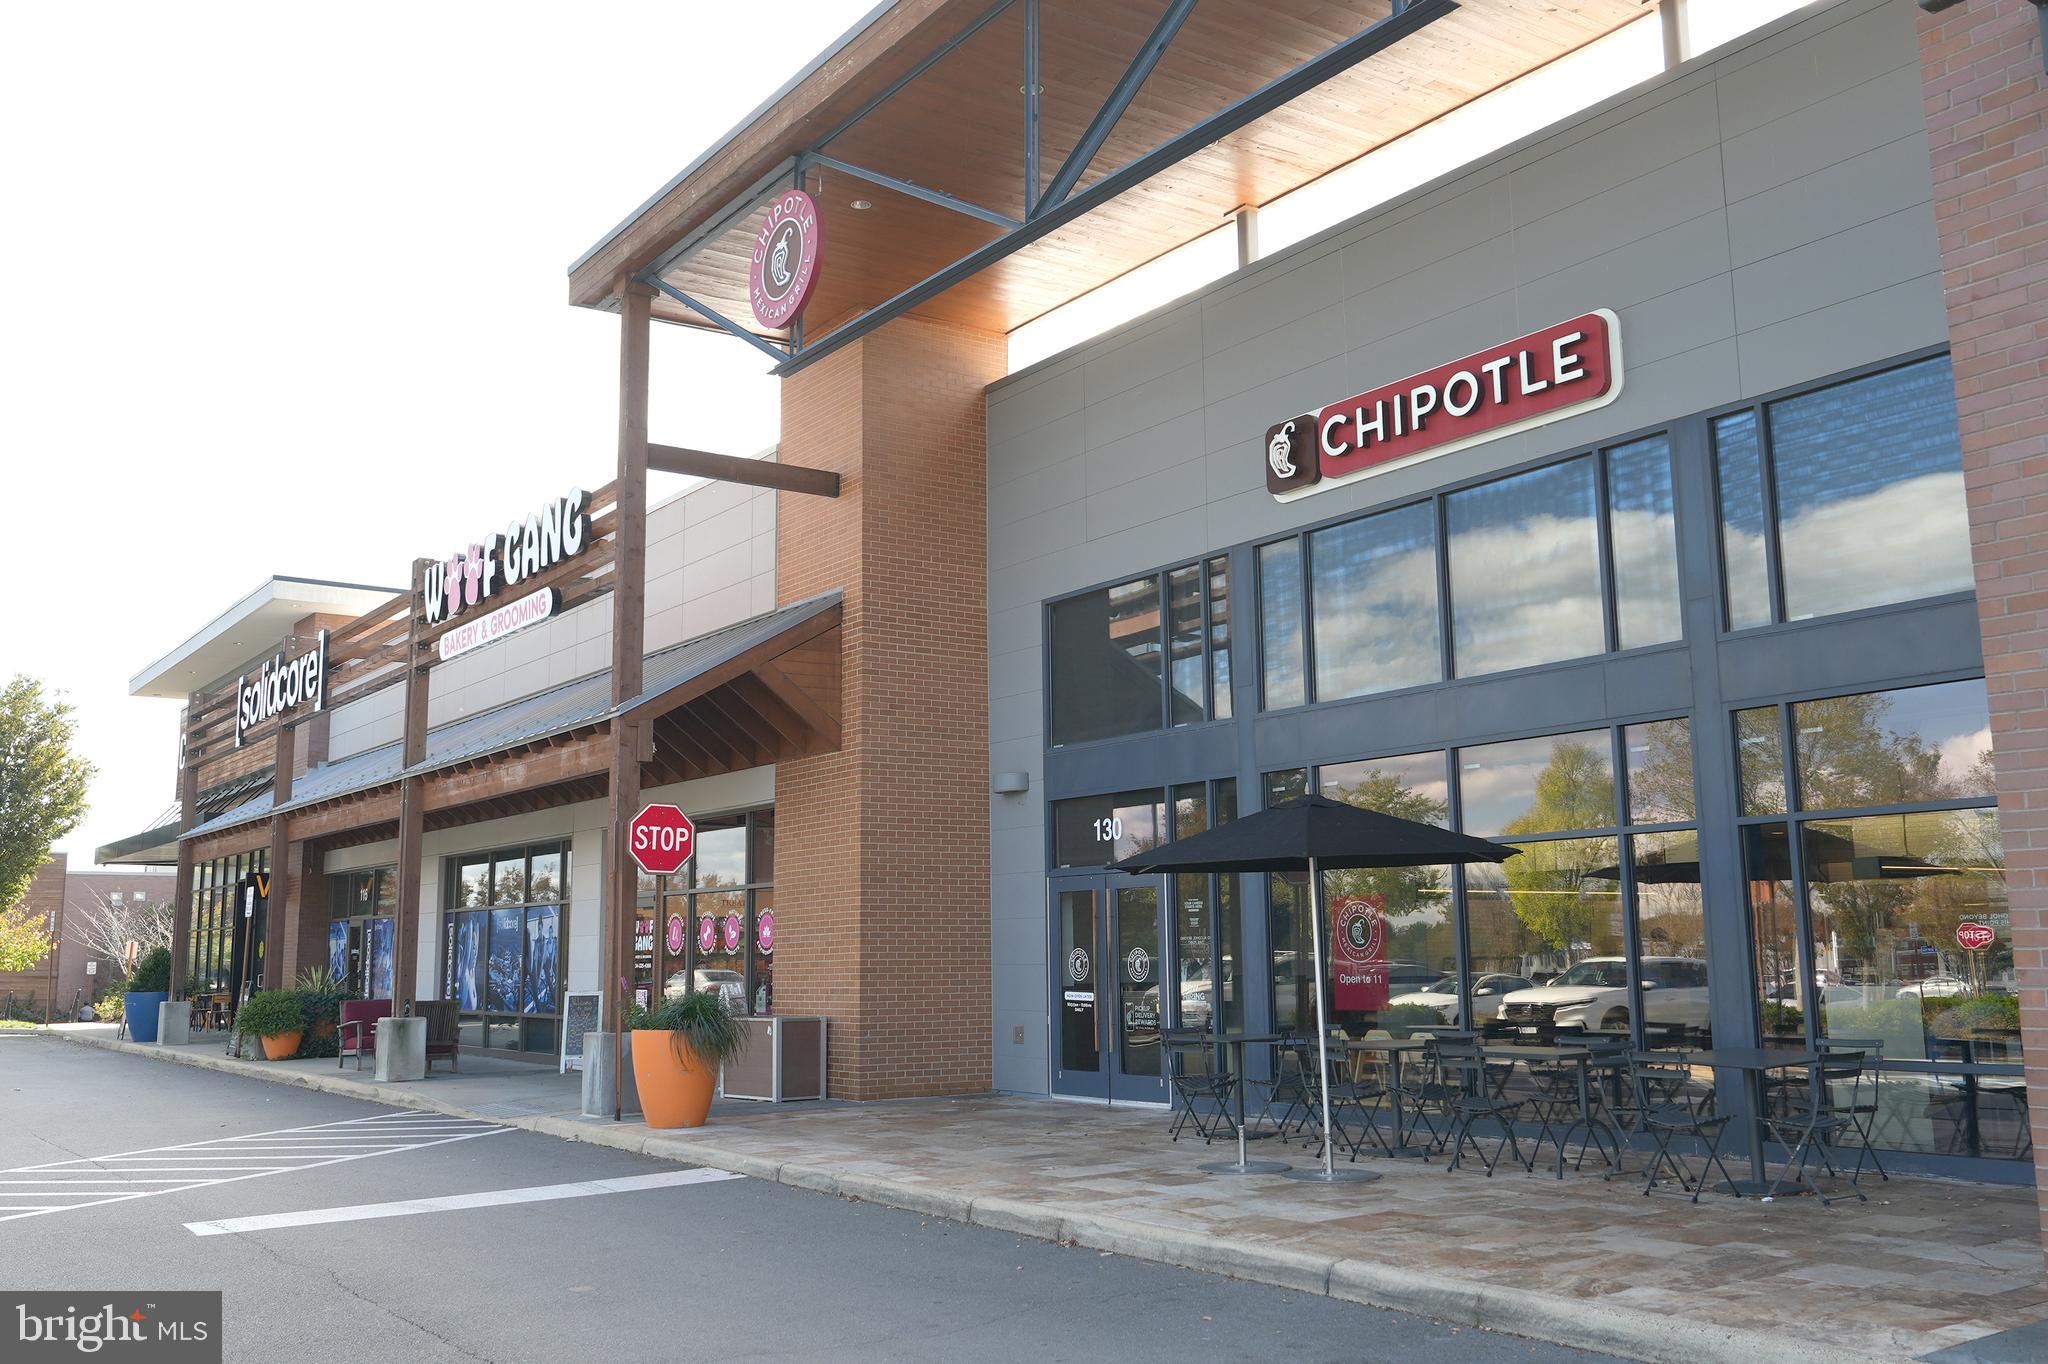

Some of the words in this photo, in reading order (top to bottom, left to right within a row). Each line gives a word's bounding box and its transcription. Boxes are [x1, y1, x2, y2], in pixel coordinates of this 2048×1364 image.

[754, 196, 813, 264] CHIPOTLE
[753, 287, 787, 319] MEXICAN
[789, 255, 811, 304] GRILL
[1321, 331, 1585, 457] CHIPOTLE
[504, 485, 589, 586] GANG
[443, 626, 479, 656] BAKERY
[481, 620, 488, 641] &
[490, 593, 547, 637] GROOMING
[634, 825, 689, 852] STOP
[1093, 817, 1122, 841] 130
[1340, 904, 1378, 927] CHIPOTLE
[1340, 974, 1360, 985] Open
[1362, 974, 1371, 984] to
[1374, 975, 1382, 984] 11
